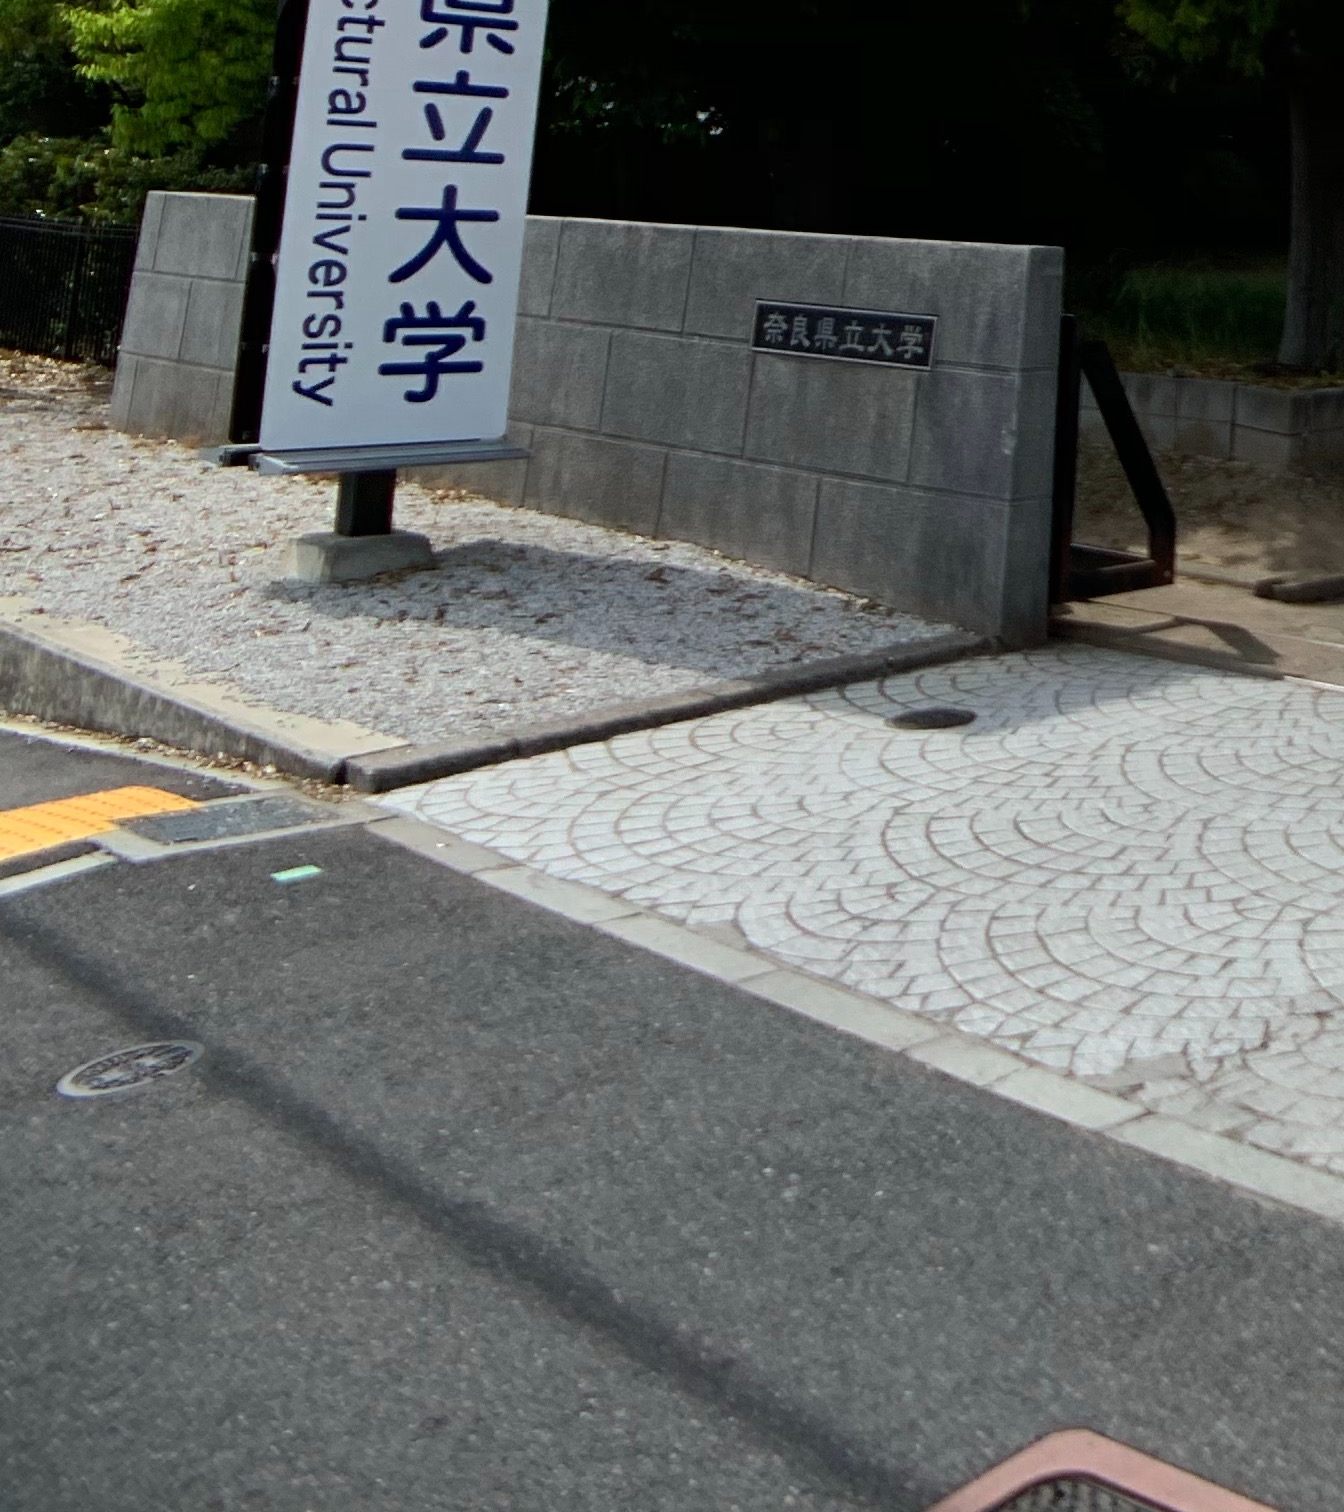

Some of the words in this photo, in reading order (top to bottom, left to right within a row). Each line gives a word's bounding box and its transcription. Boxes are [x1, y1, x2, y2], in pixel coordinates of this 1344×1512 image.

[291, 143, 376, 408] University
[763, 312, 925, 359] 奈良県立大学
